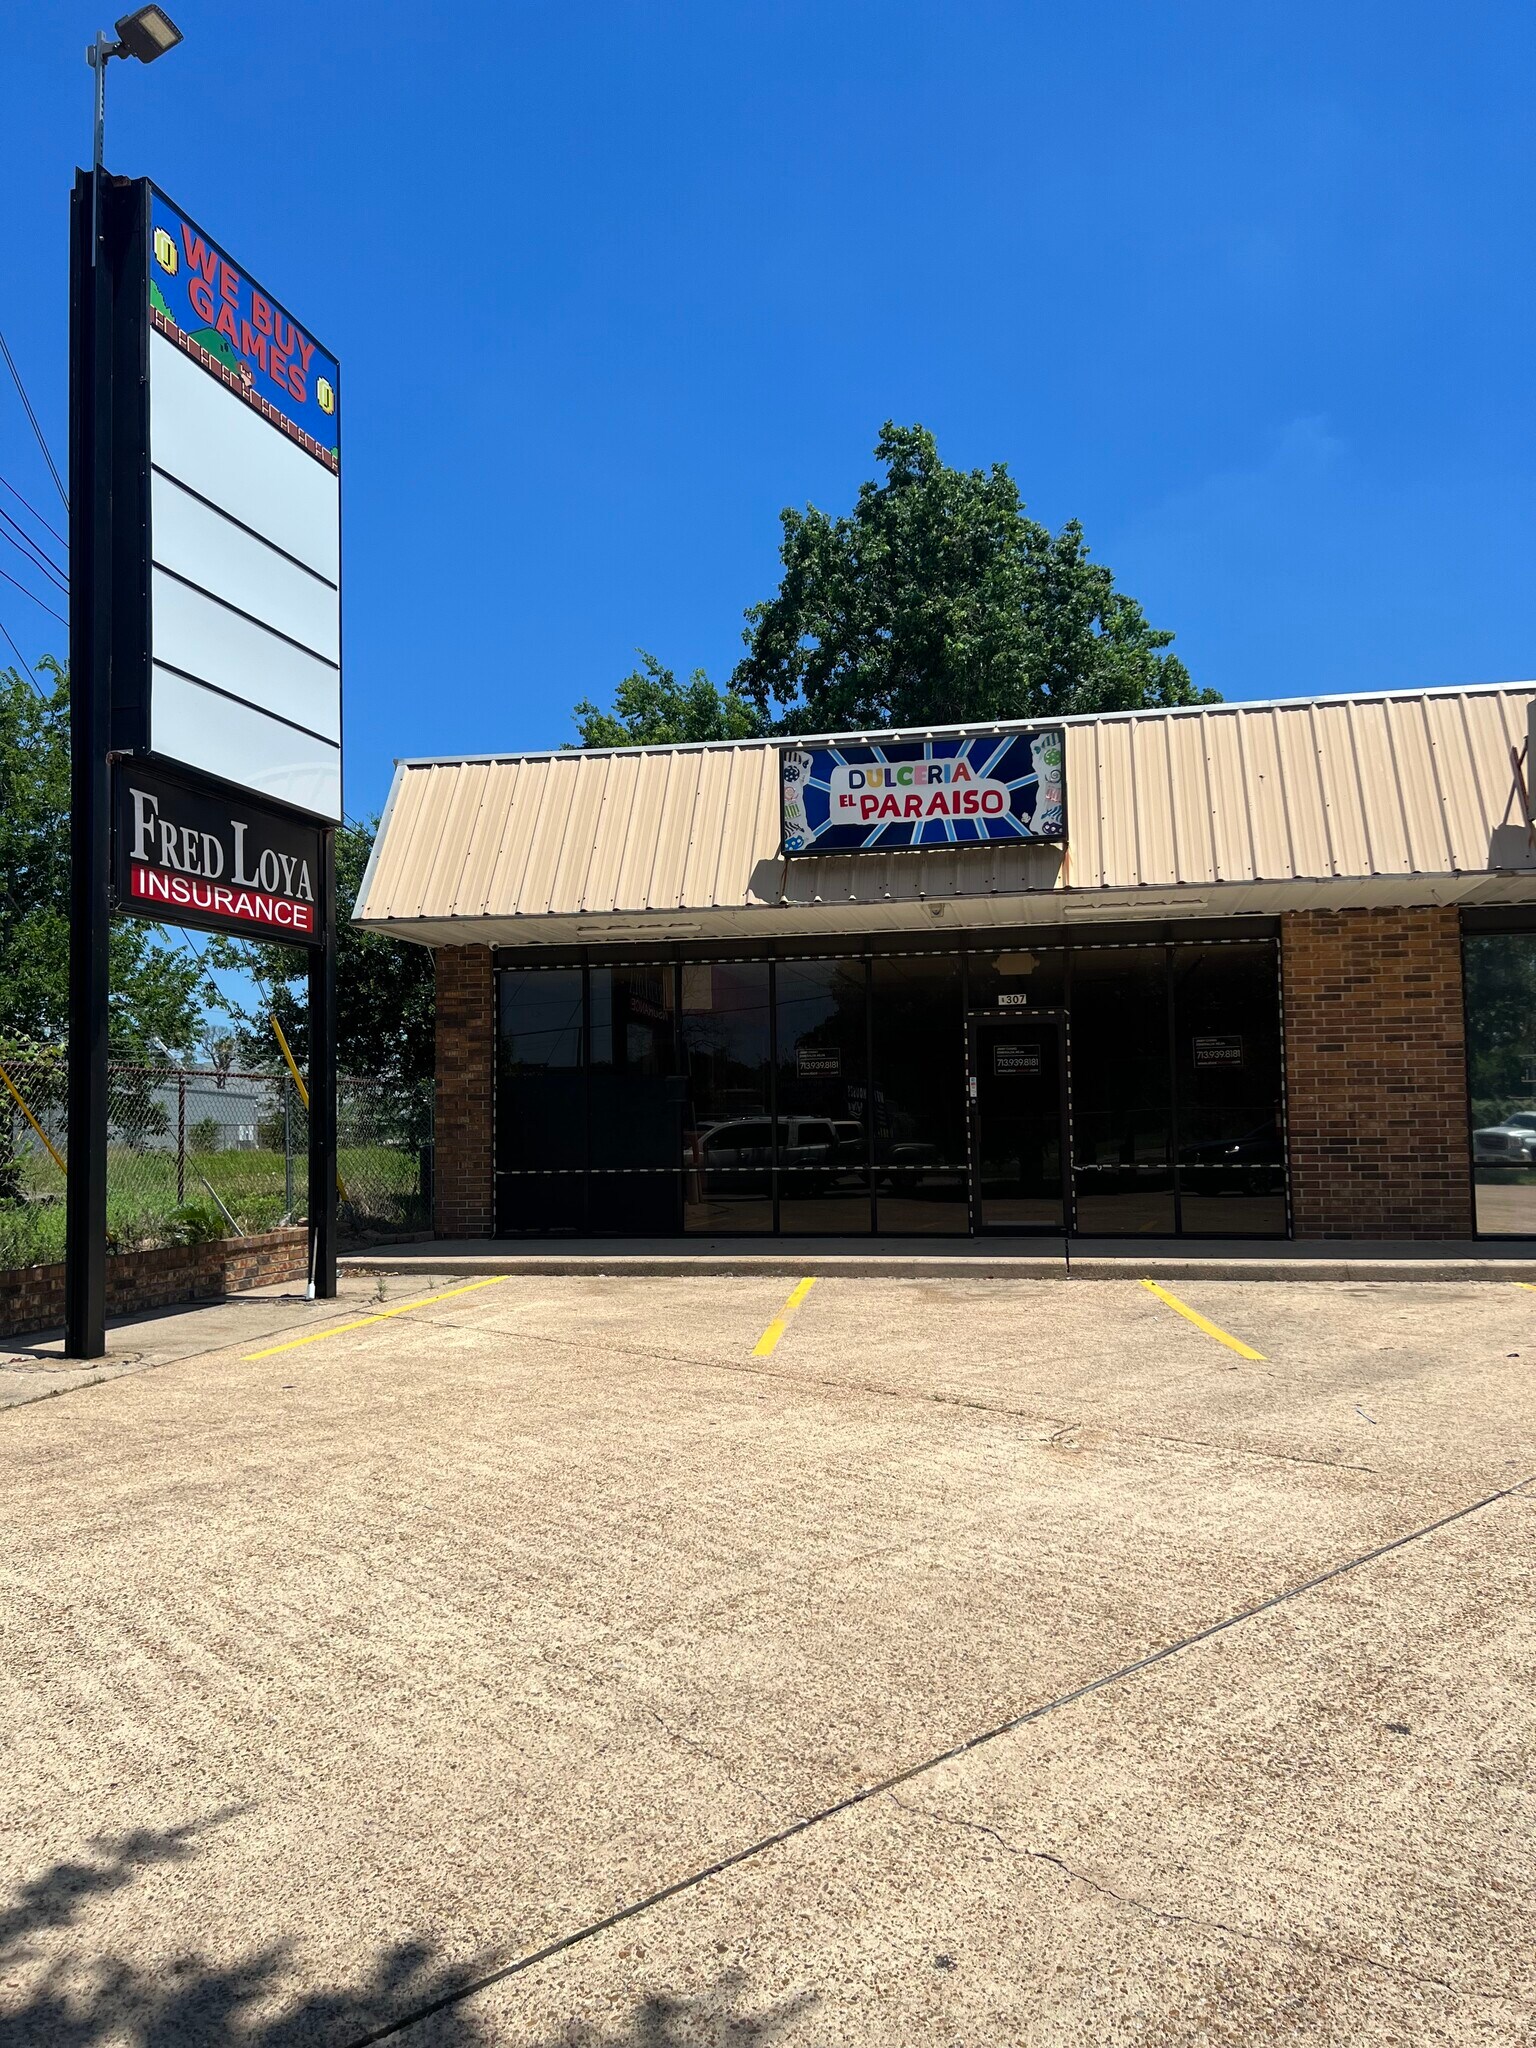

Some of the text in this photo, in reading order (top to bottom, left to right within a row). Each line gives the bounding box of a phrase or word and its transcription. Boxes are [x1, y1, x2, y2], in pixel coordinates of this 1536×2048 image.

[181, 223, 316, 373] WE BUY
[188, 277, 307, 403] GAMES
[849, 762, 972, 789] DULCERIA
[839, 789, 1004, 820] EL PARAISO
[129, 787, 315, 902] FRED LOYA
[139, 868, 308, 929] INSURANCE
[799, 1061, 839, 1070] 713.939.8181
[997, 1058, 1039, 1067] 713.939.8181
[1196, 1049, 1241, 1060] 713.939.8181
